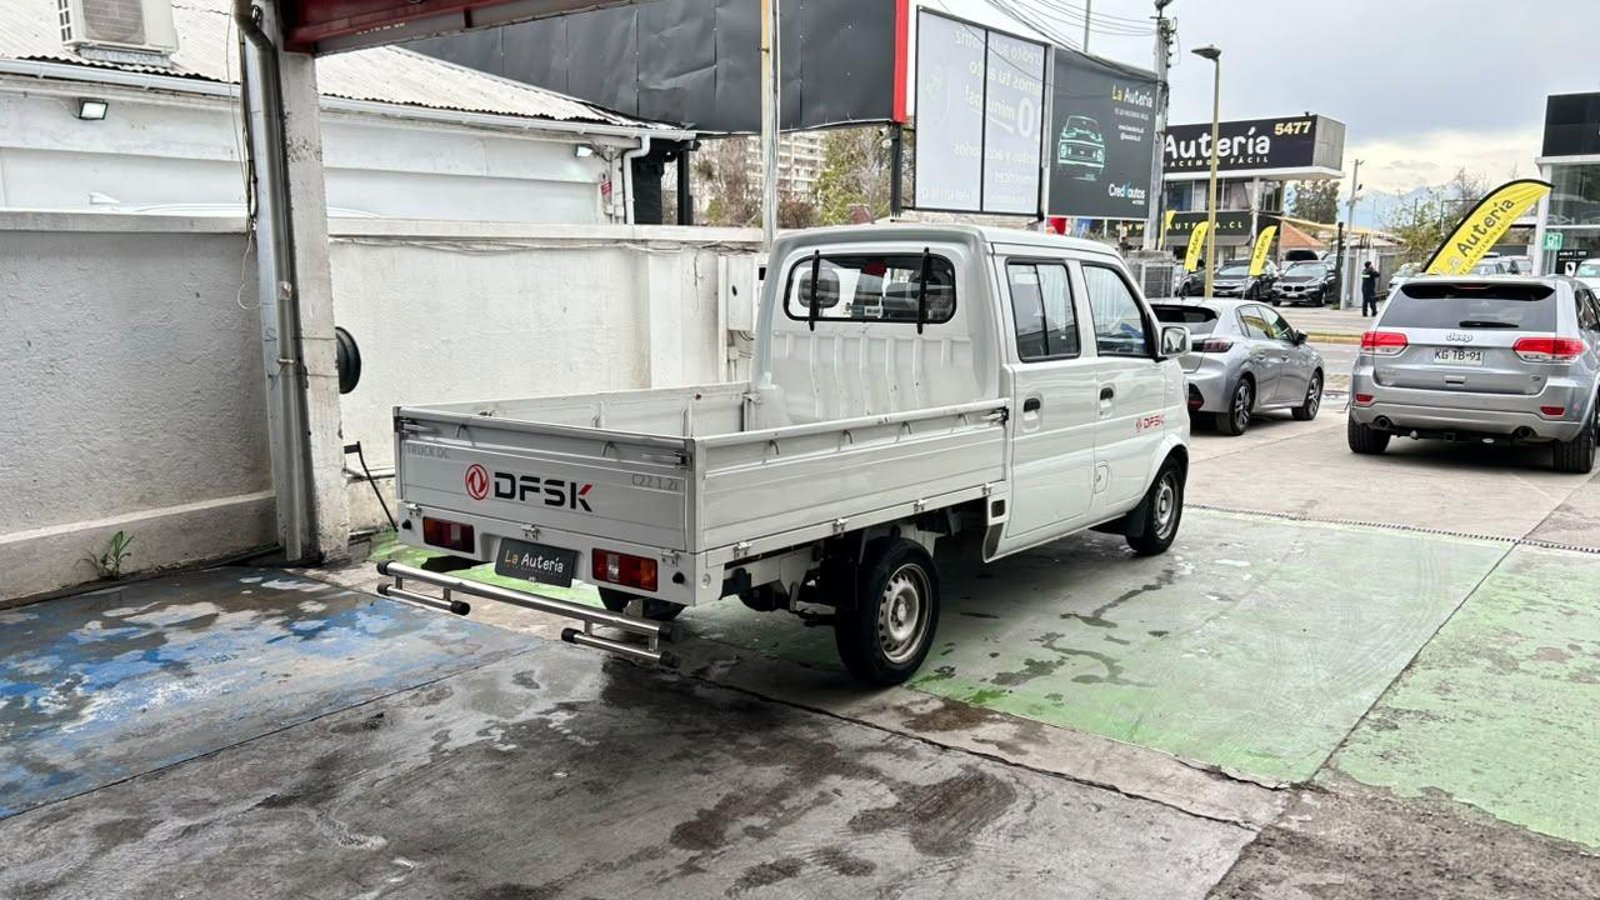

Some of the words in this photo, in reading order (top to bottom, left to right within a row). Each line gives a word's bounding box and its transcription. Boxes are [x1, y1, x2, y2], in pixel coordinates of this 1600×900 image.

[1112, 84, 1122, 101] La
[1274, 121, 1312, 136] 5477
[1165, 126, 1270, 160] Autería
[1456, 199, 1515, 257] Autería
[1445, 331, 1473, 344] Jeep
[1434, 350, 1449, 360] KG
[1143, 414, 1166, 429] DFSK
[632, 473, 653, 488] C22
[494, 471, 593, 512] DFSK
[504, 549, 519, 565] La
[520, 552, 564, 573] Autería
